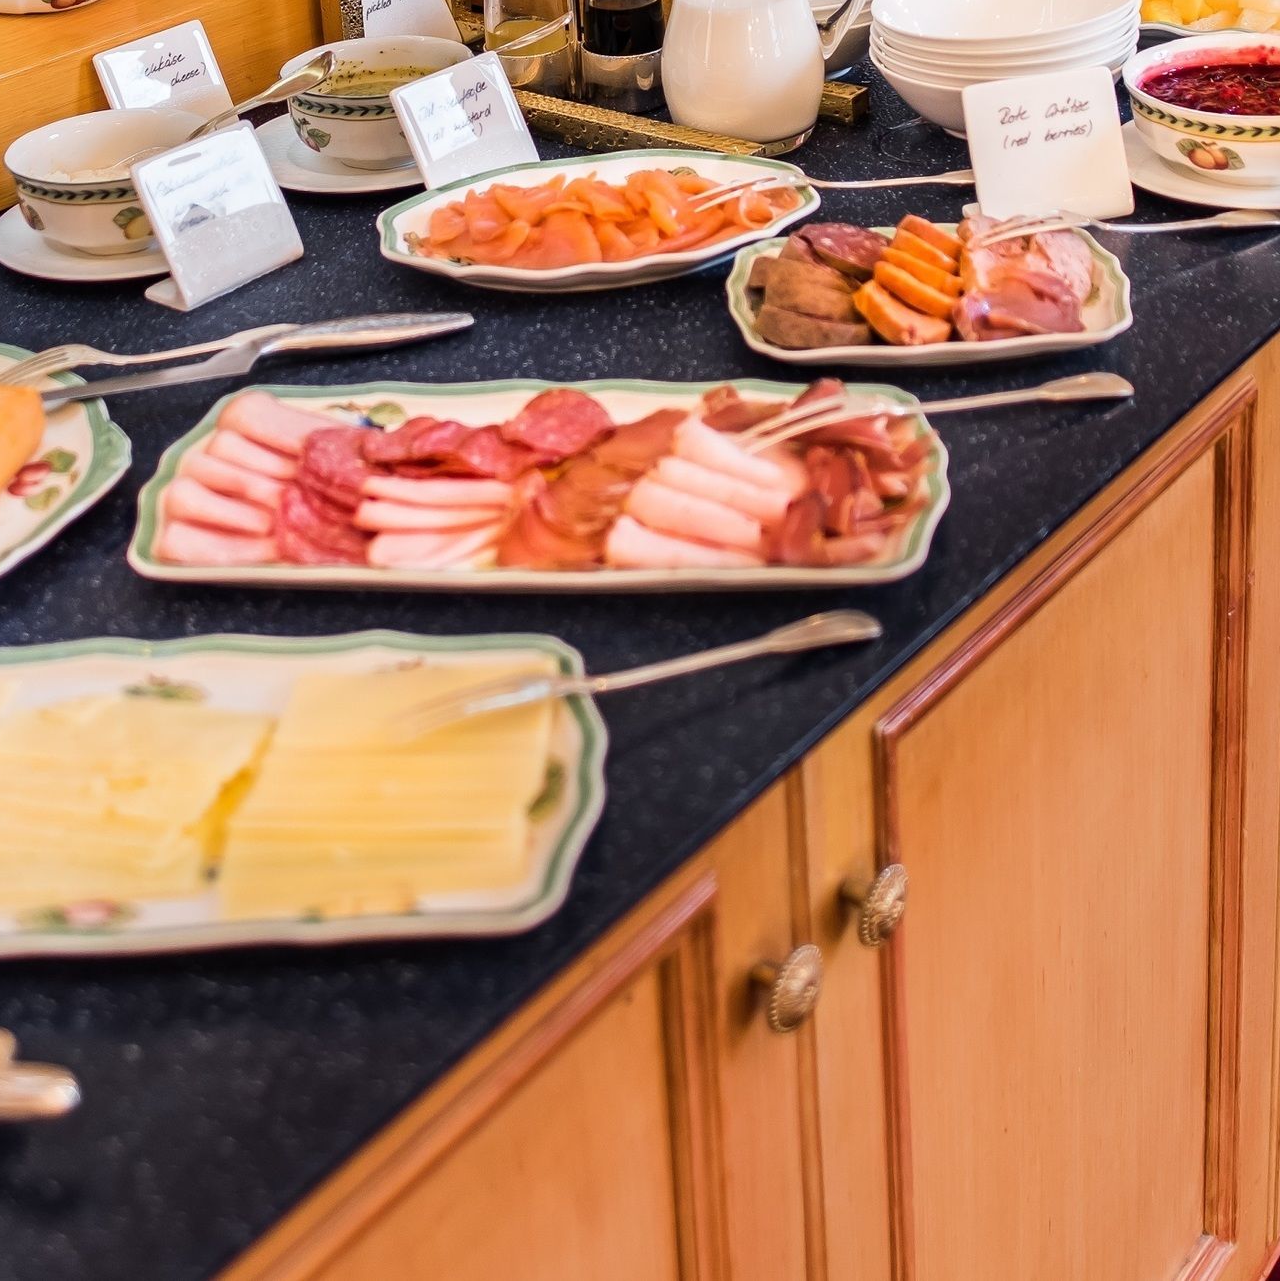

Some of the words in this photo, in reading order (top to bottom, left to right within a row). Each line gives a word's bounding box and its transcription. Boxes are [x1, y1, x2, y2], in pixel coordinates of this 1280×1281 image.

[998, 105, 1030, 125] Rote
[1003, 131, 1032, 150] (red
[1044, 119, 1093, 142] berries)
